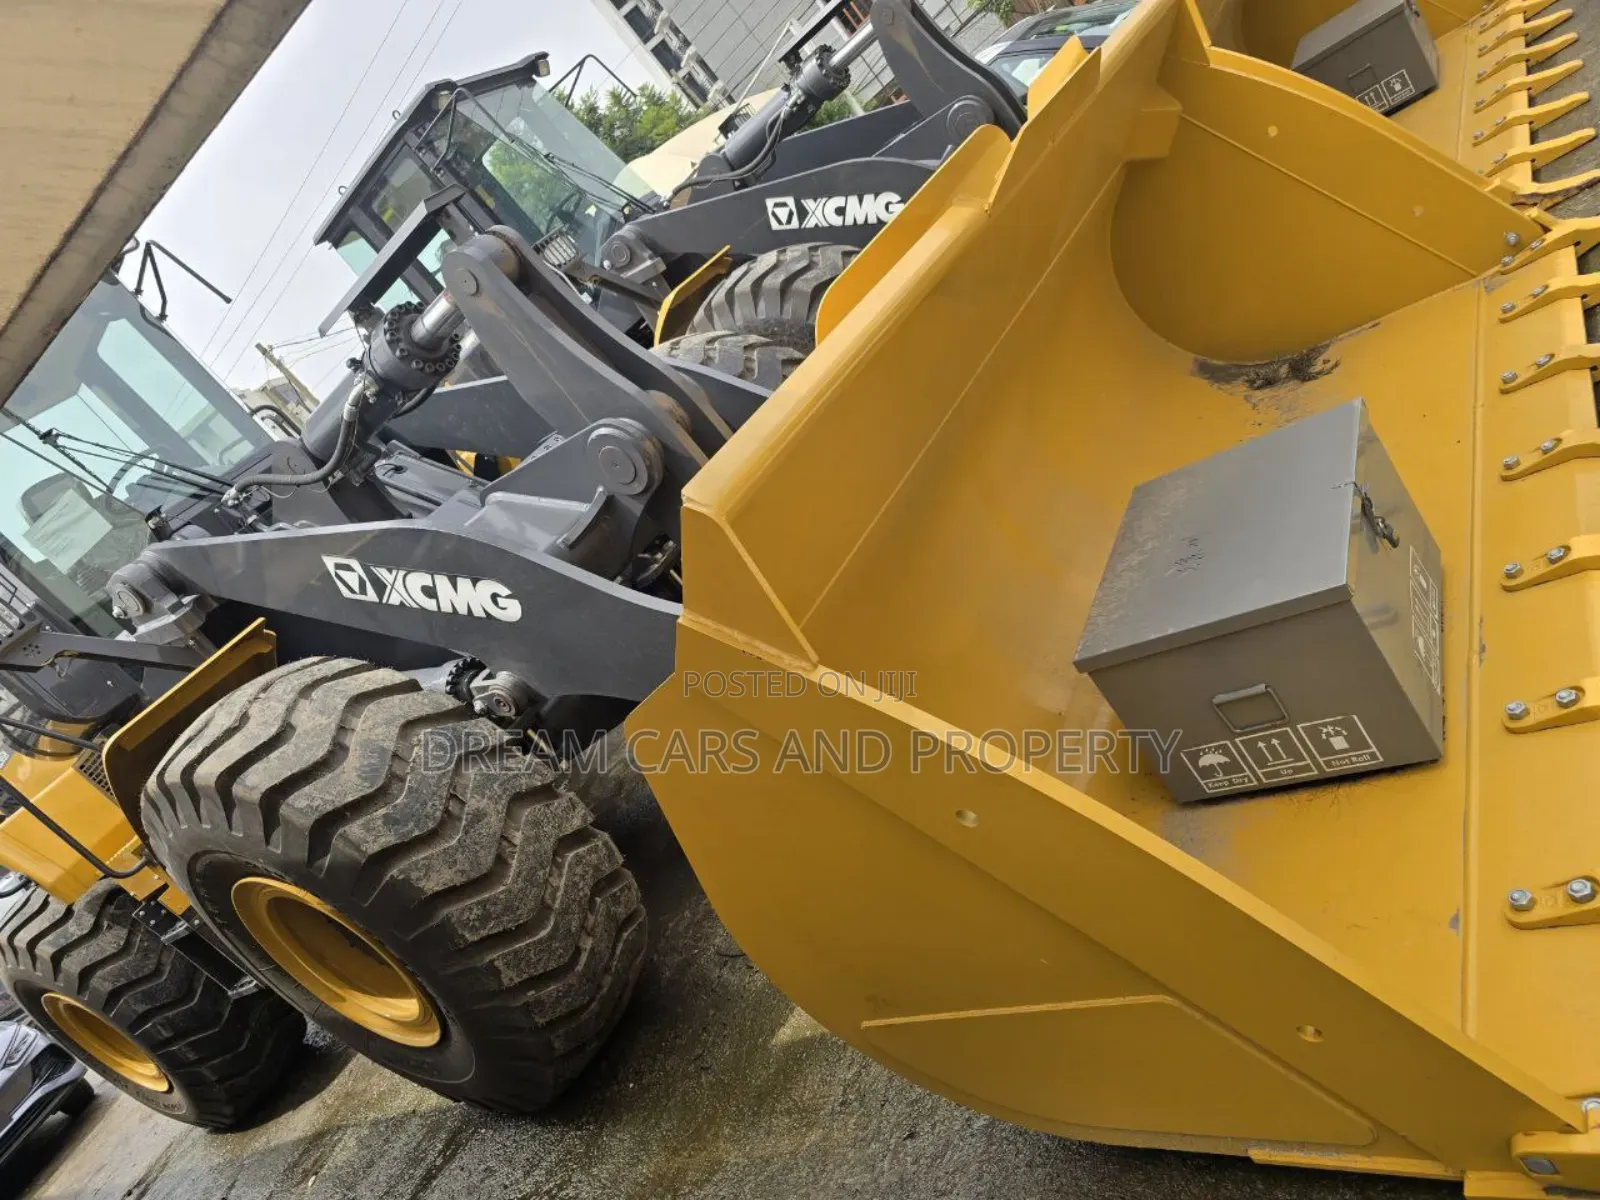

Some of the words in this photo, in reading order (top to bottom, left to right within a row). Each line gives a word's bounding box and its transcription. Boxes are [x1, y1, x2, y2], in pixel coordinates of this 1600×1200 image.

[800, 191, 905, 229] XCMG
[370, 565, 522, 623] XCMG
[1331, 757, 1350, 767] Not
[1350, 754, 1371, 764] Roll
[1279, 767, 1294, 776] Up
[1208, 780, 1230, 789] Keep
[1231, 776, 1250, 786] Dry
